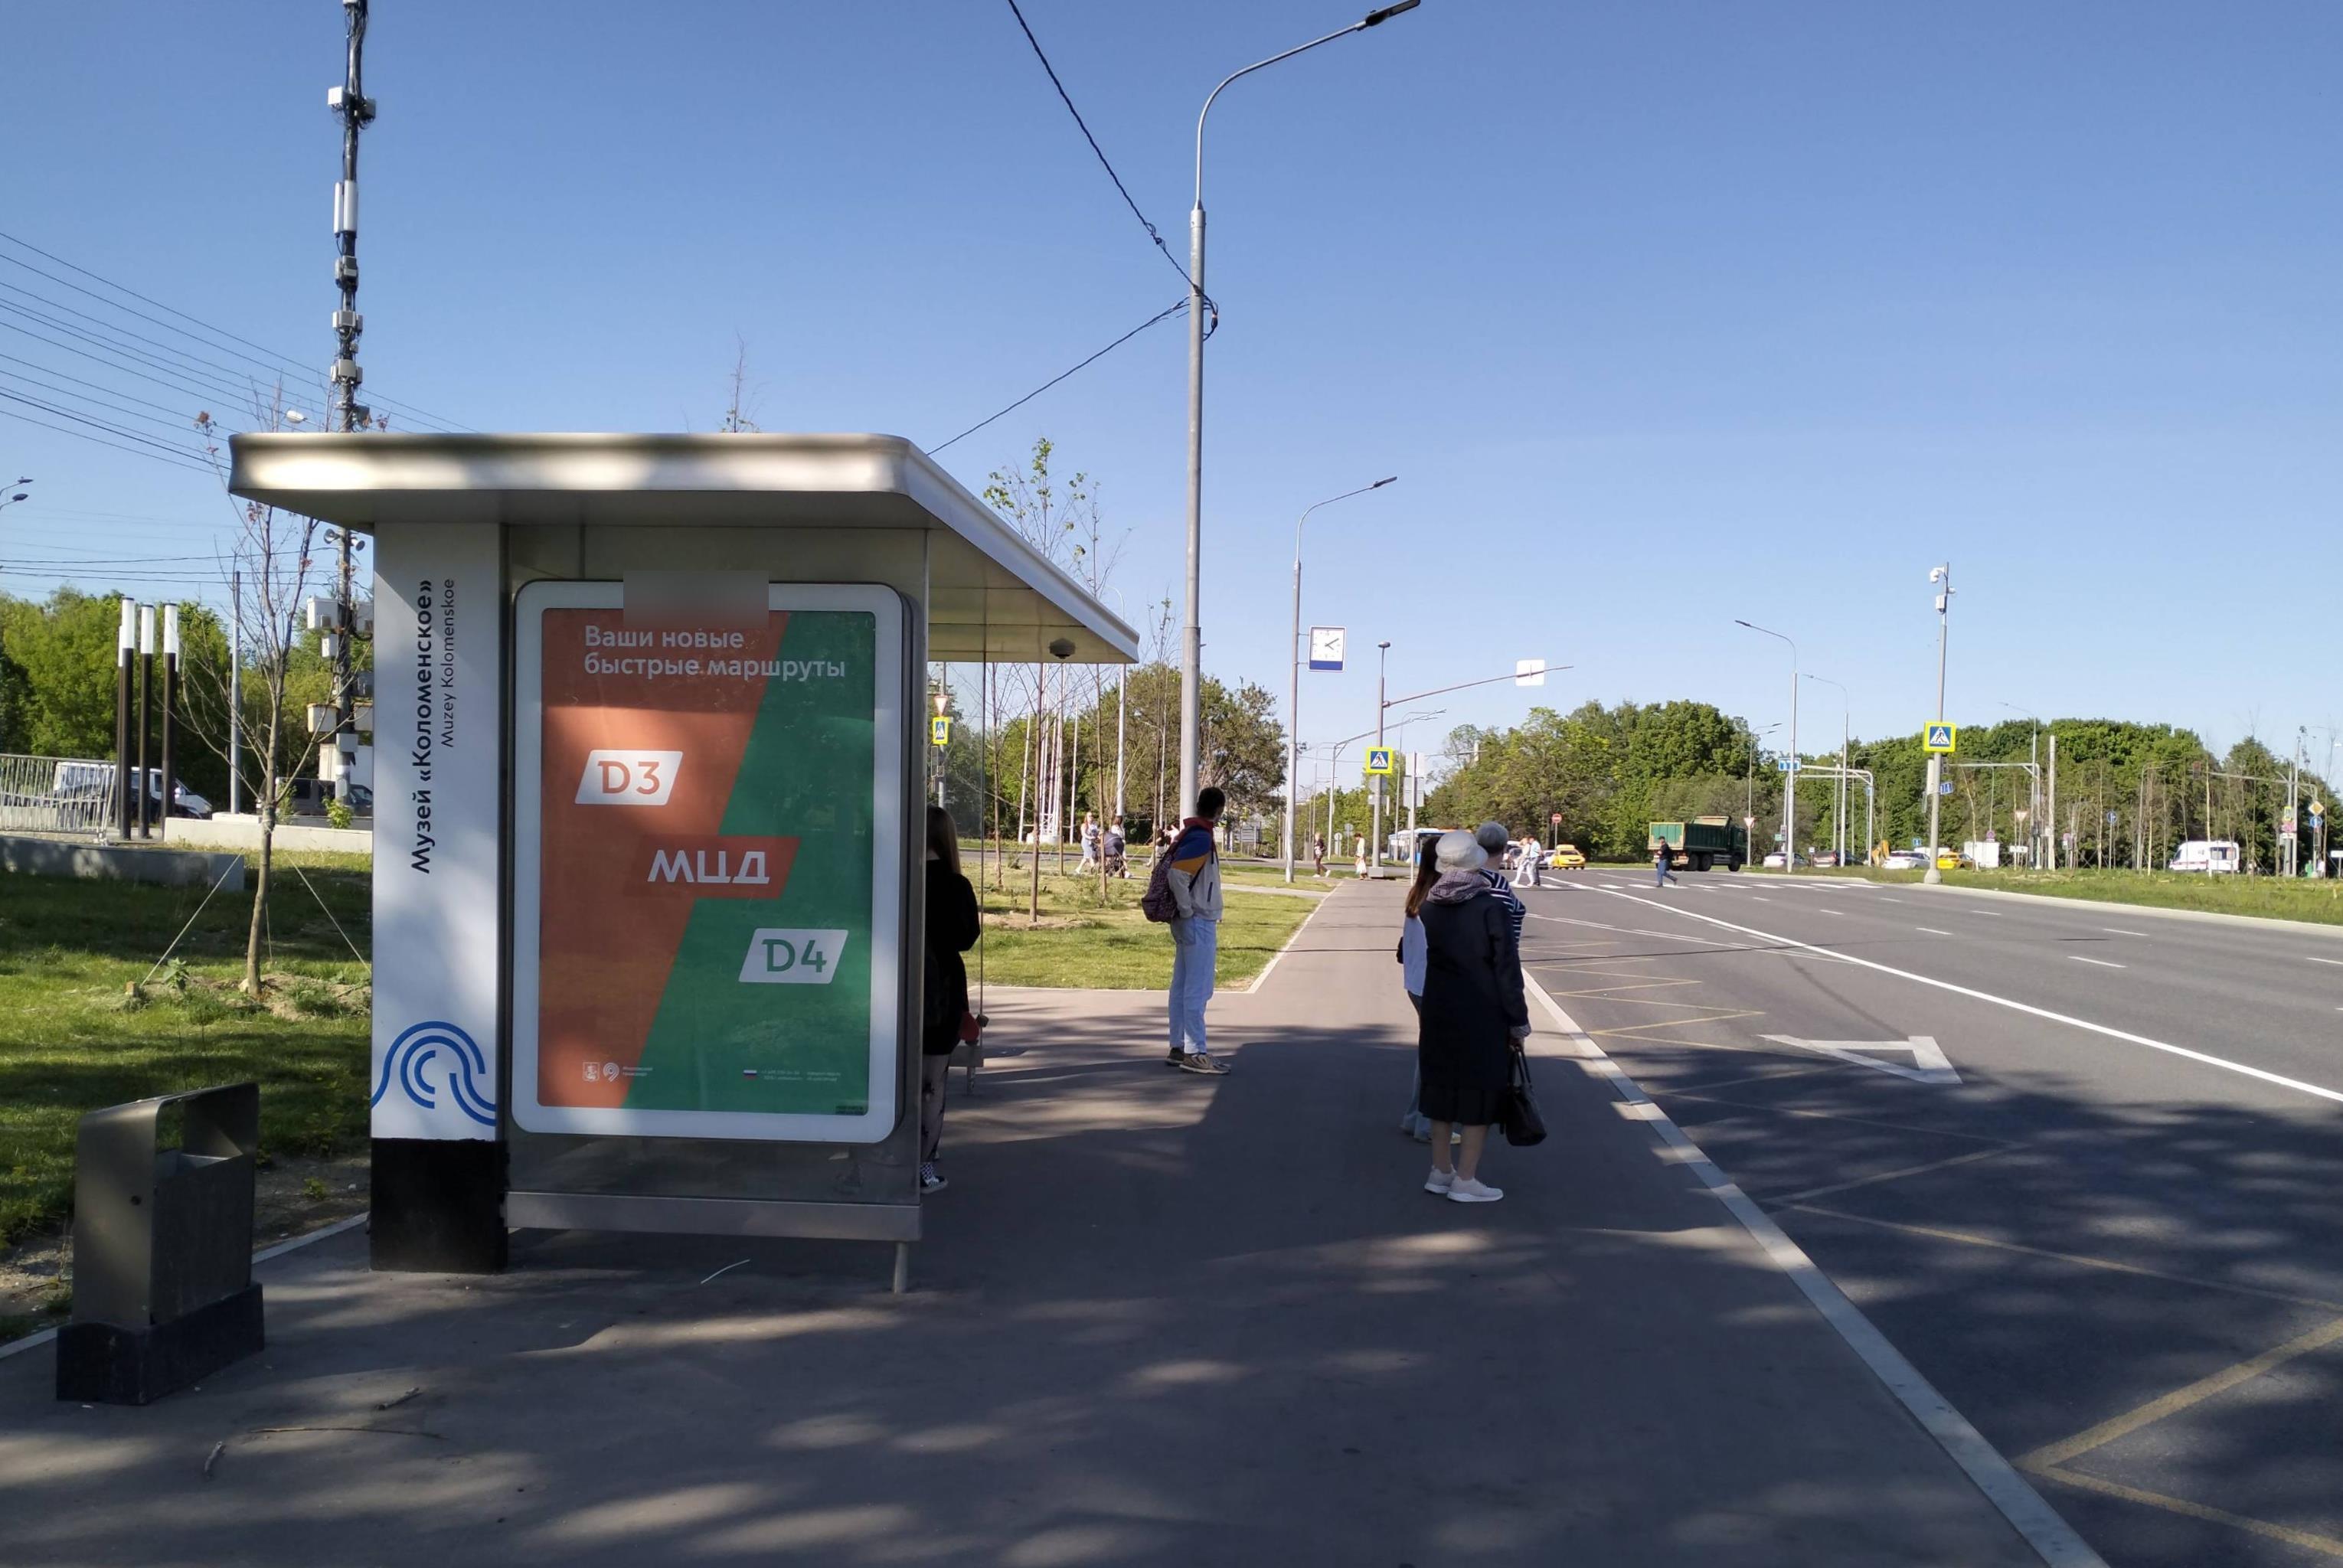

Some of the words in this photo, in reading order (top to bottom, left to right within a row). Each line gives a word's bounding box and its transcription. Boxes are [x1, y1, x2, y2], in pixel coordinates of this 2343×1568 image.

[440, 579, 454, 688] Kolomenskoe
[585, 626, 654, 648] Ваши
[662, 630, 743, 648] новые
[412, 580, 433, 782] «Коломенское»
[584, 652, 699, 678] быстрые
[708, 659, 846, 681] маршруты
[440, 693, 456, 747] Muzey
[597, 760, 661, 794] D3
[411, 789, 436, 874] Музей
[647, 850, 770, 884] МЦД
[761, 939, 828, 973] D4
